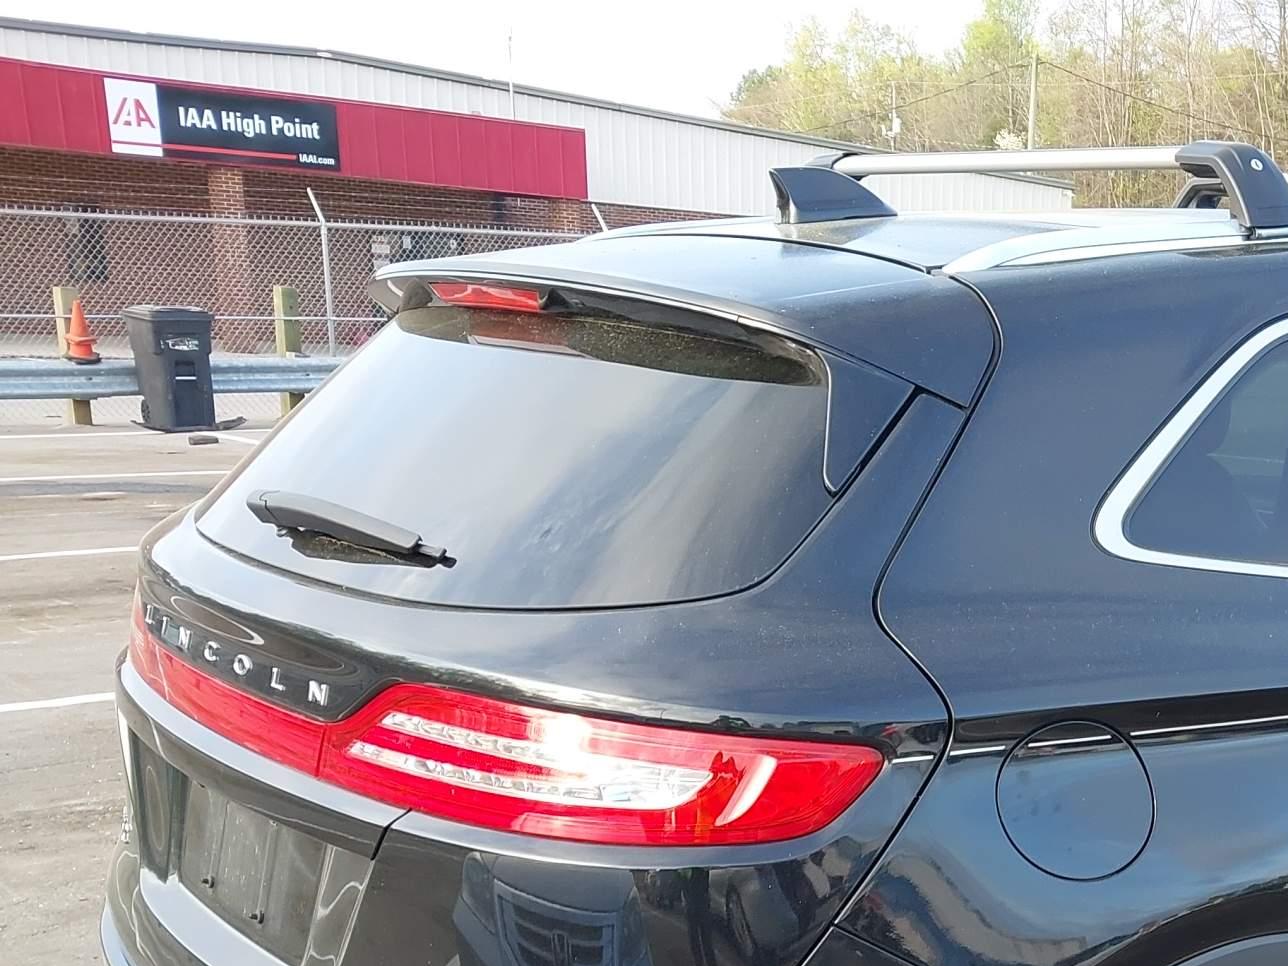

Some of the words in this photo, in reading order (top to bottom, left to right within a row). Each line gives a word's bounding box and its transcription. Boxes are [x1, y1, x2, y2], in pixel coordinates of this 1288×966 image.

[178, 106, 218, 131] IAA
[220, 110, 267, 138] High
[270, 115, 321, 140] Point
[144, 604, 331, 707] LINCOLN
